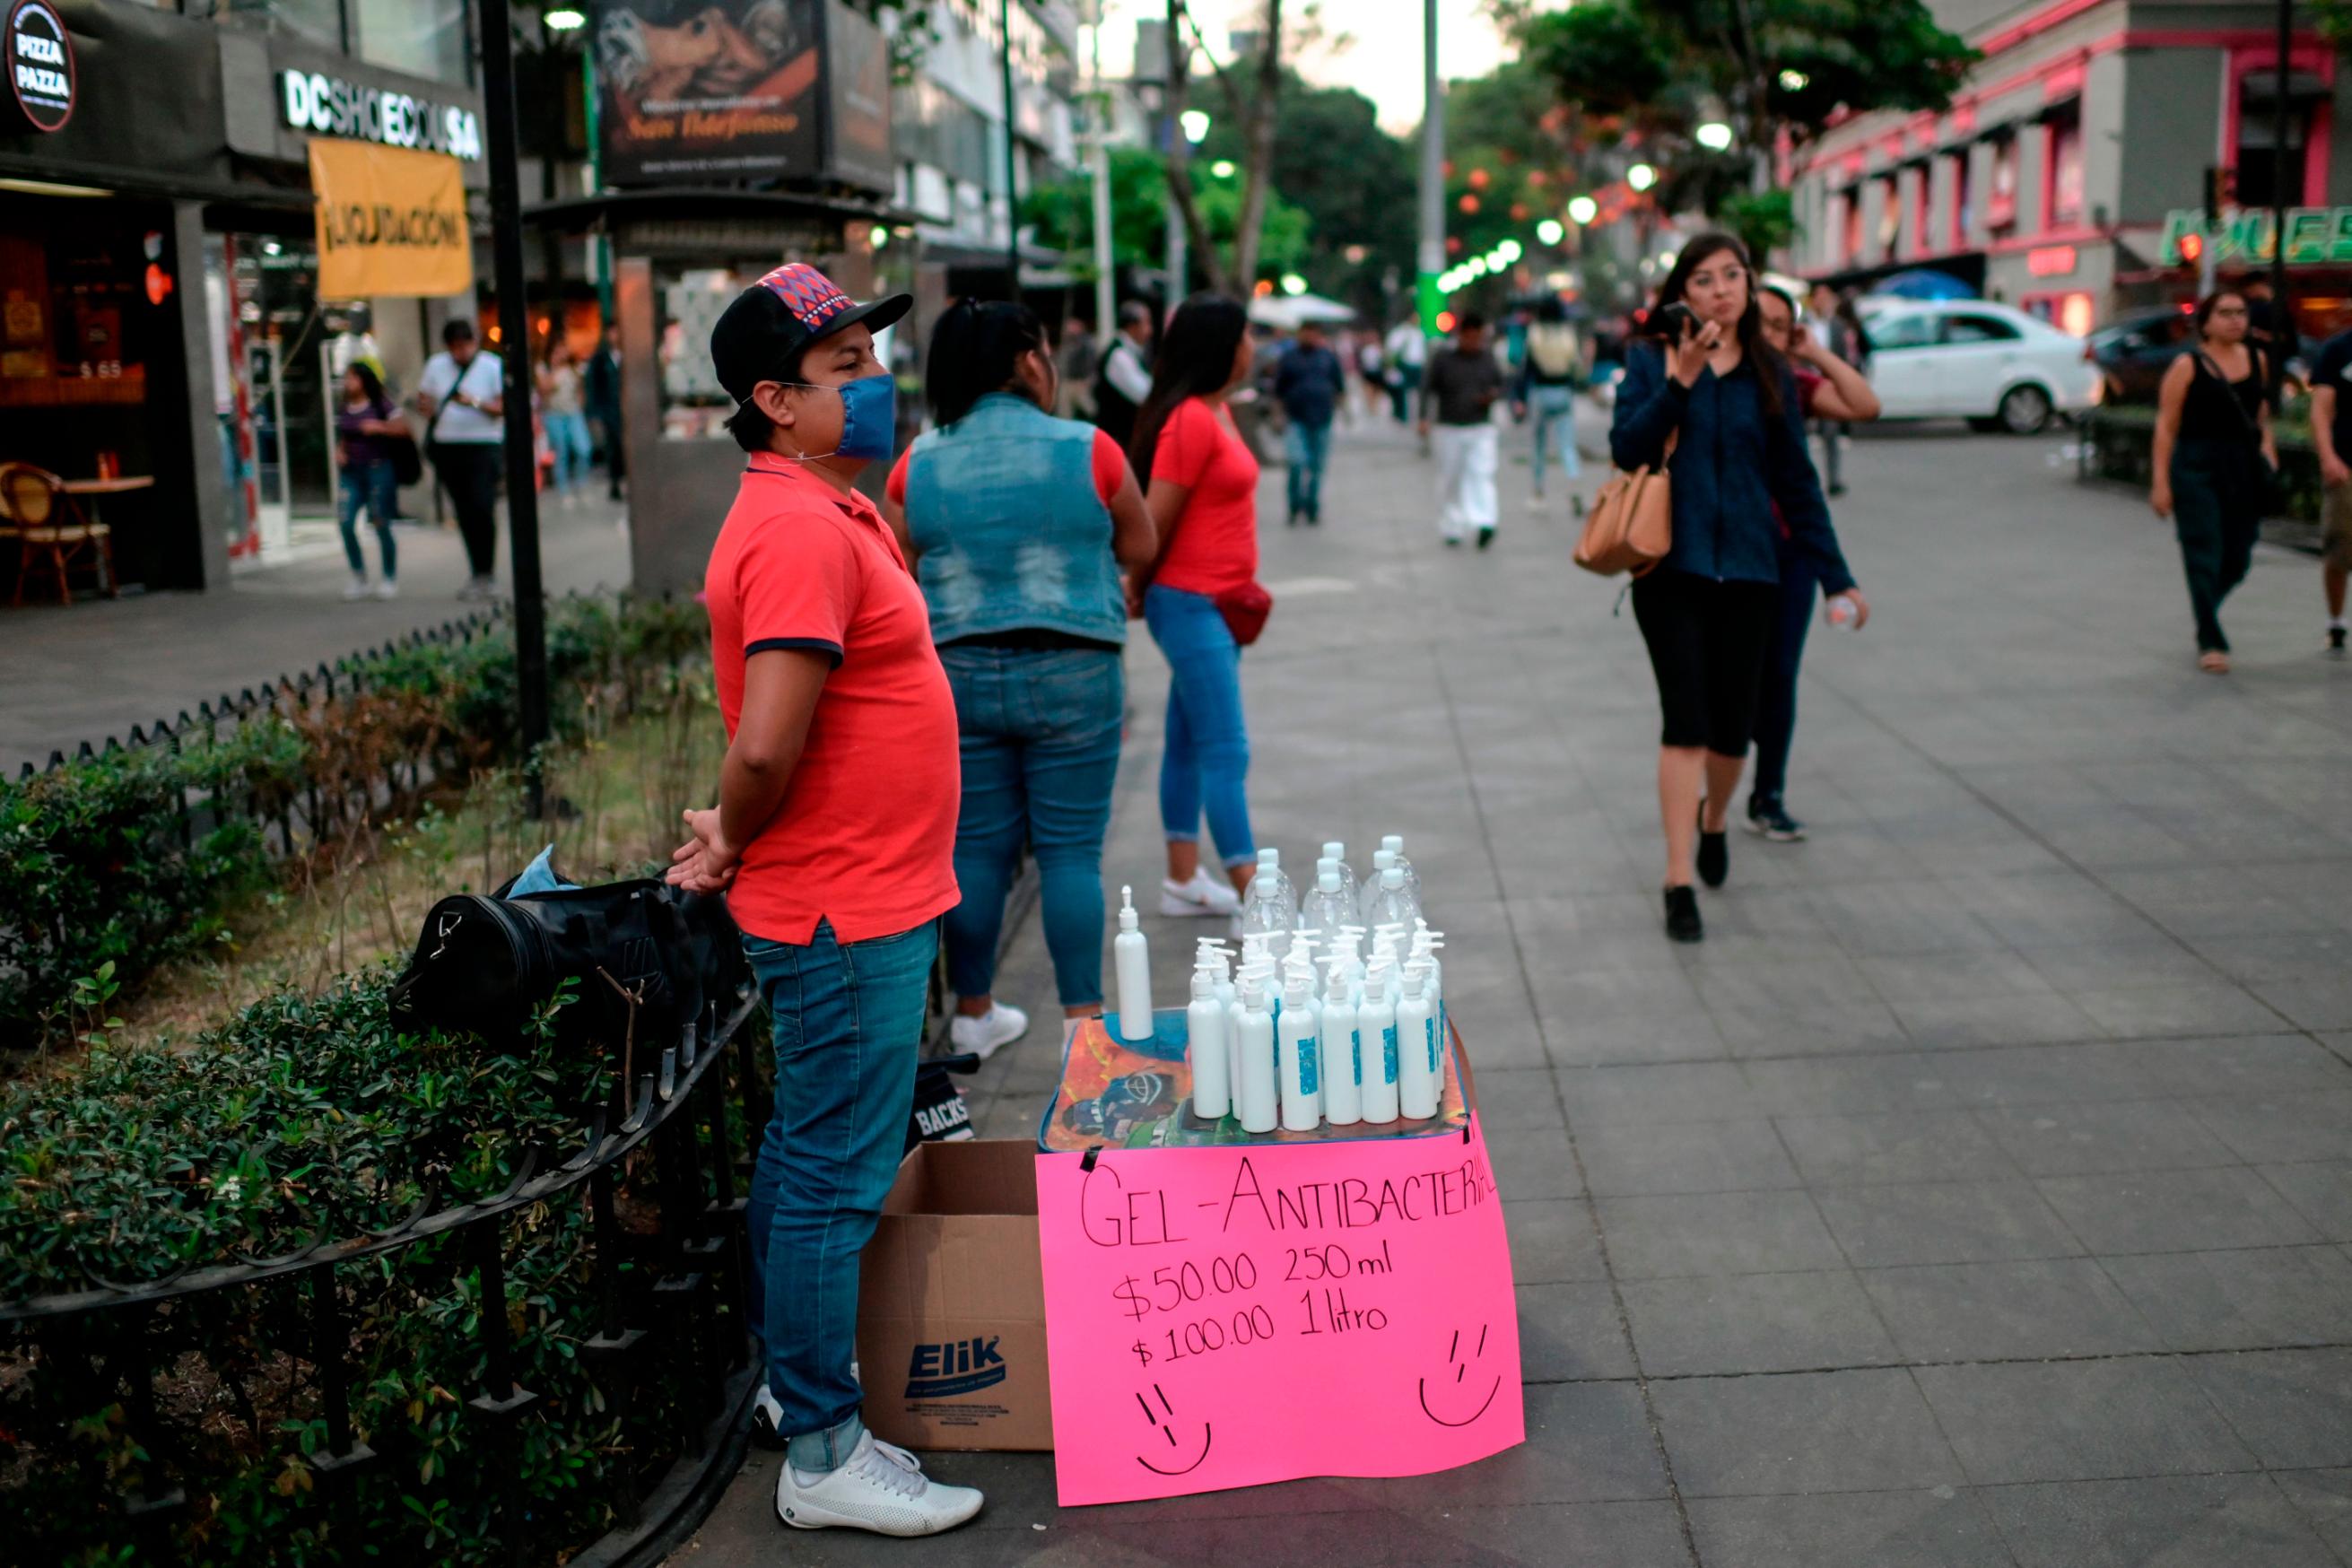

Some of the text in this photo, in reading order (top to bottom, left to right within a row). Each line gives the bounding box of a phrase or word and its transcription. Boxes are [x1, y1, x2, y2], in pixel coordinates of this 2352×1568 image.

[16, 33, 64, 66] PIZZA
[16, 64, 70, 98] PAZZA
[915, 1097, 969, 1137] BACKS
